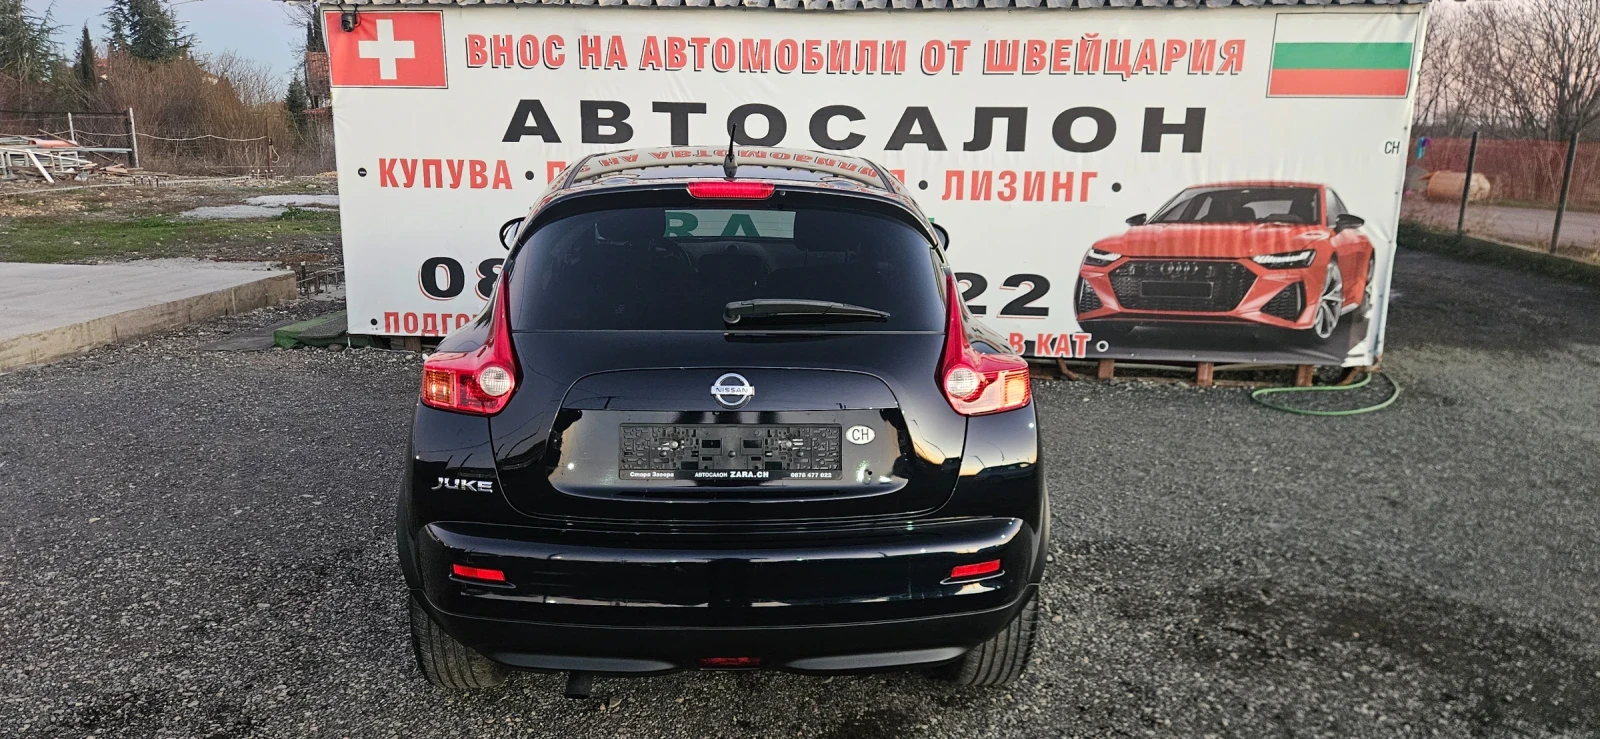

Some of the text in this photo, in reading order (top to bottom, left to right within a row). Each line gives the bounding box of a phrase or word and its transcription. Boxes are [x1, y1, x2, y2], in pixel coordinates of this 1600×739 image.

[465, 32, 1246, 81] ВНОС НА АВТОМОБИЛИ ОТ ШВЕЙЦАРИЯ
[501, 99, 1207, 154] АВТОСАЛОН
[1384, 140, 1400, 155] CH
[378, 157, 513, 190] КУПУВА
[941, 169, 1098, 203] ЛИЗИНГ
[384, 311, 478, 337] ПОДГО
[1034, 332, 1092, 358] КАТ
[851, 428, 870, 442] CH
[431, 476, 494, 494] JUKE
[730, 470, 770, 478] ZARA.CH
